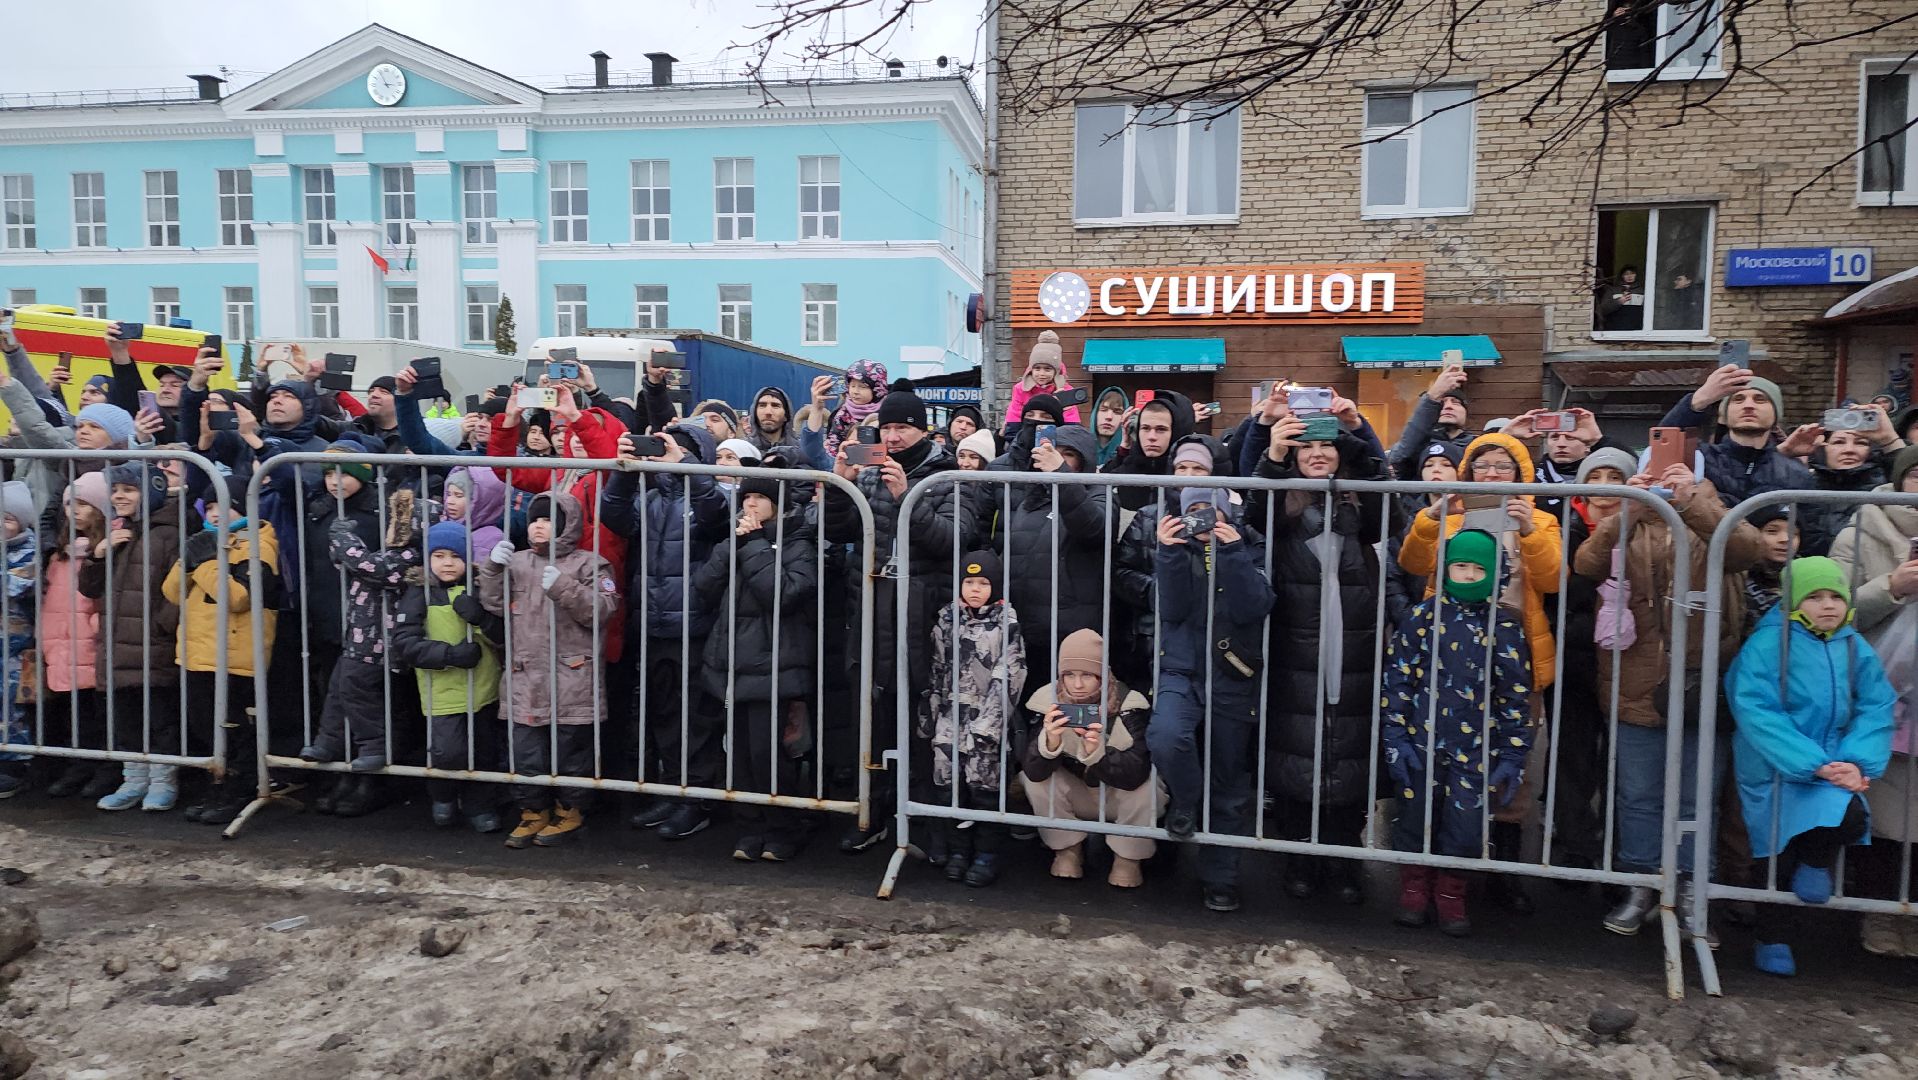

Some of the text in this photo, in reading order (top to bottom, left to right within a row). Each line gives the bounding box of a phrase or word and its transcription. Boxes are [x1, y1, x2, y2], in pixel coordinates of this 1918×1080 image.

[1735, 253, 1866, 277] Московский 10
[1100, 272, 1396, 316] СУШИШОП
[913, 388, 948, 400] МОНТ
